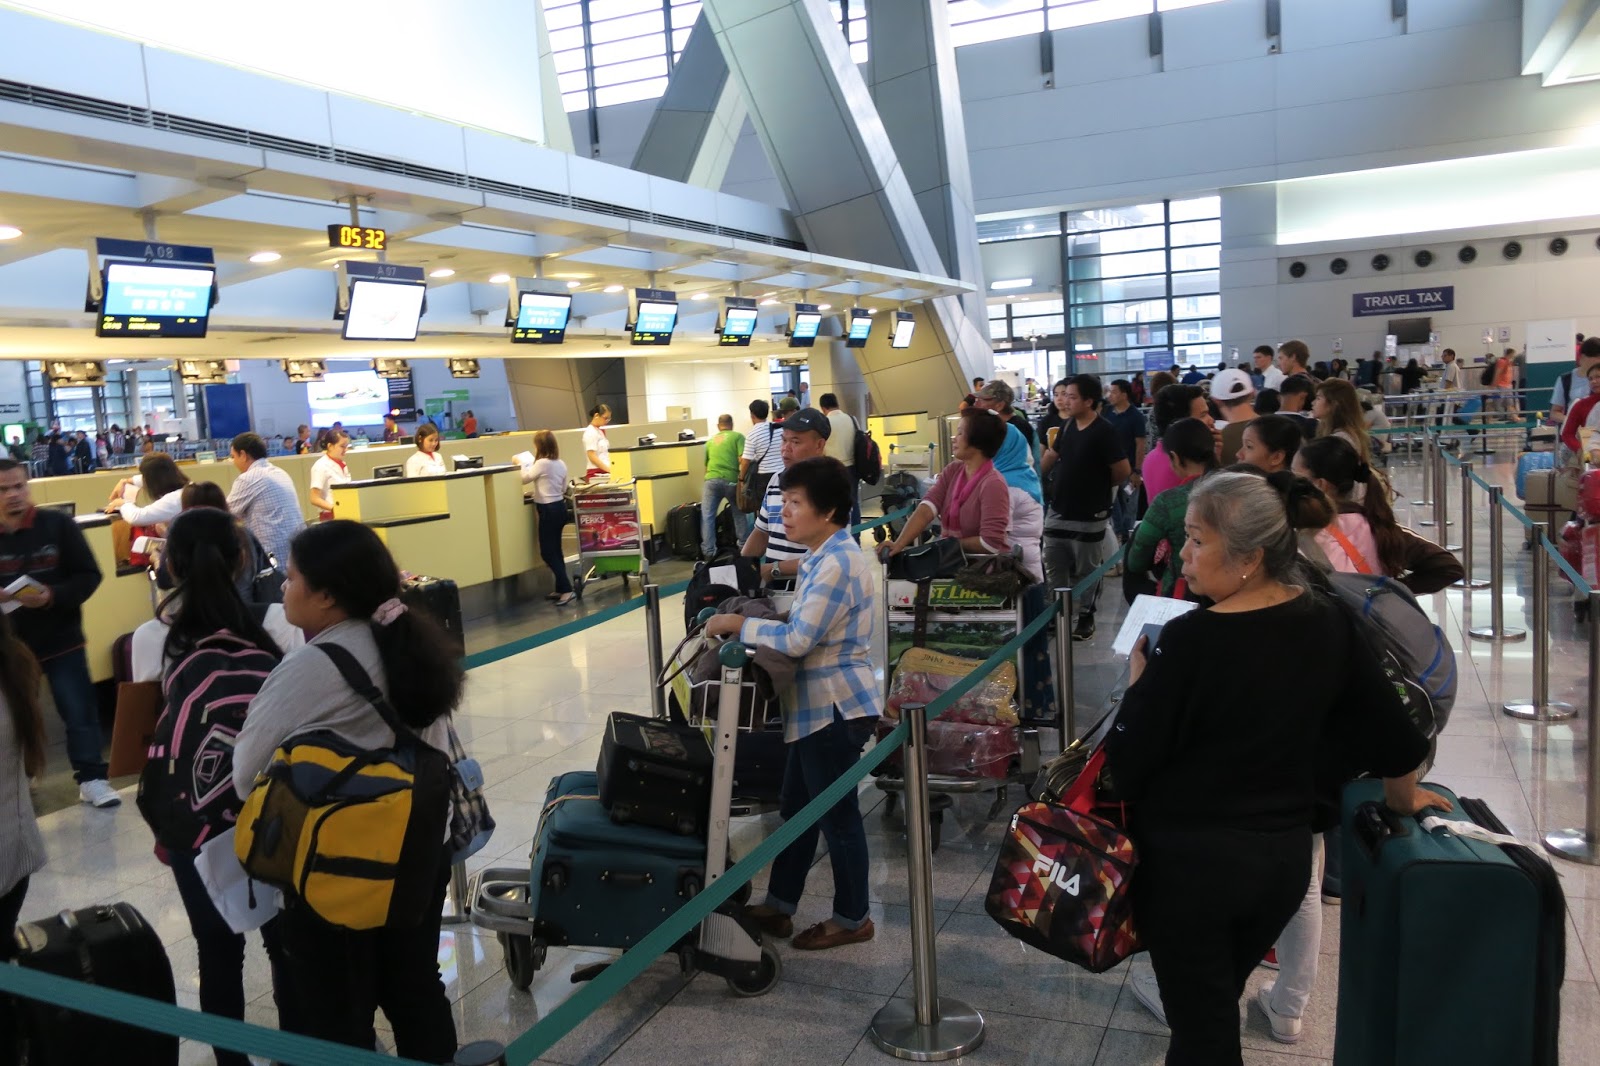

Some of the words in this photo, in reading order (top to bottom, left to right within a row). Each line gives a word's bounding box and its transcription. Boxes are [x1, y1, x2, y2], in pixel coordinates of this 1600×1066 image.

[144, 244, 154, 257] A
[157, 246, 174, 259] 08
[1363, 294, 1413, 307] TRAVEL
[1416, 291, 1443, 303] TAX
[1033, 854, 1080, 896] FILA
